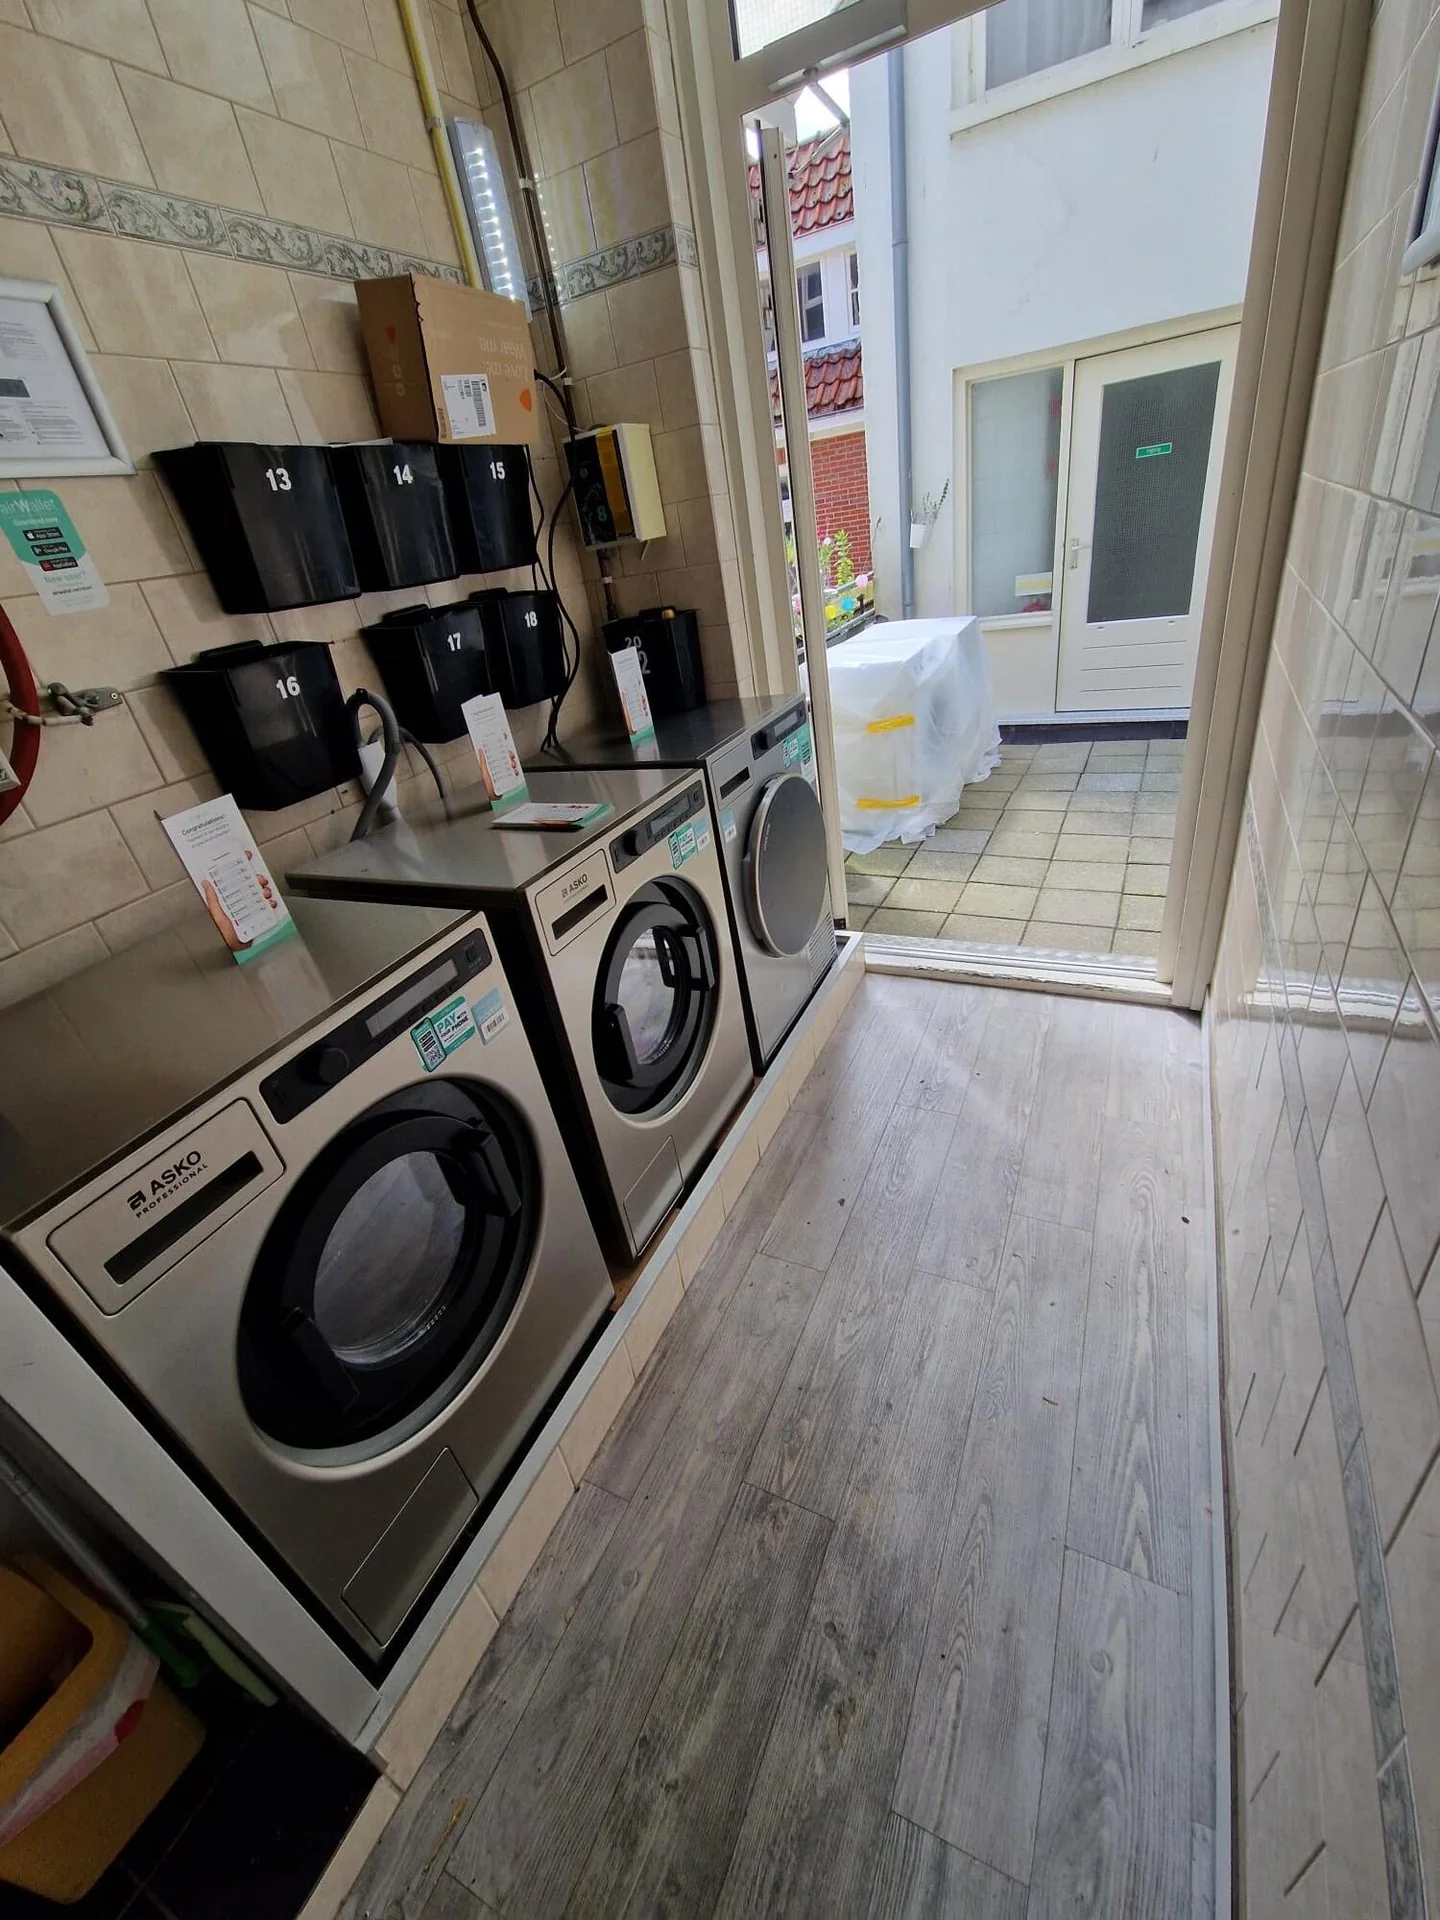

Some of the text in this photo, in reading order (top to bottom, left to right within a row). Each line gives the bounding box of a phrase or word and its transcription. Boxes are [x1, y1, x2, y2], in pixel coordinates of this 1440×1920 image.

[265, 468, 292, 492] 13
[393, 464, 413, 485] 14
[489, 461, 506, 480] 15
[524, 611, 538, 628] 18
[447, 632, 461, 652] 17
[624, 636, 642, 649] 20
[276, 676, 300, 699] 16
[569, 873, 588, 892] ASKO
[436, 1012, 457, 1032] PAY
[451, 1015, 469, 1032] PHONE
[150, 1150, 202, 1196] ASKO
[136, 1163, 208, 1219] PROFESSIONAL
